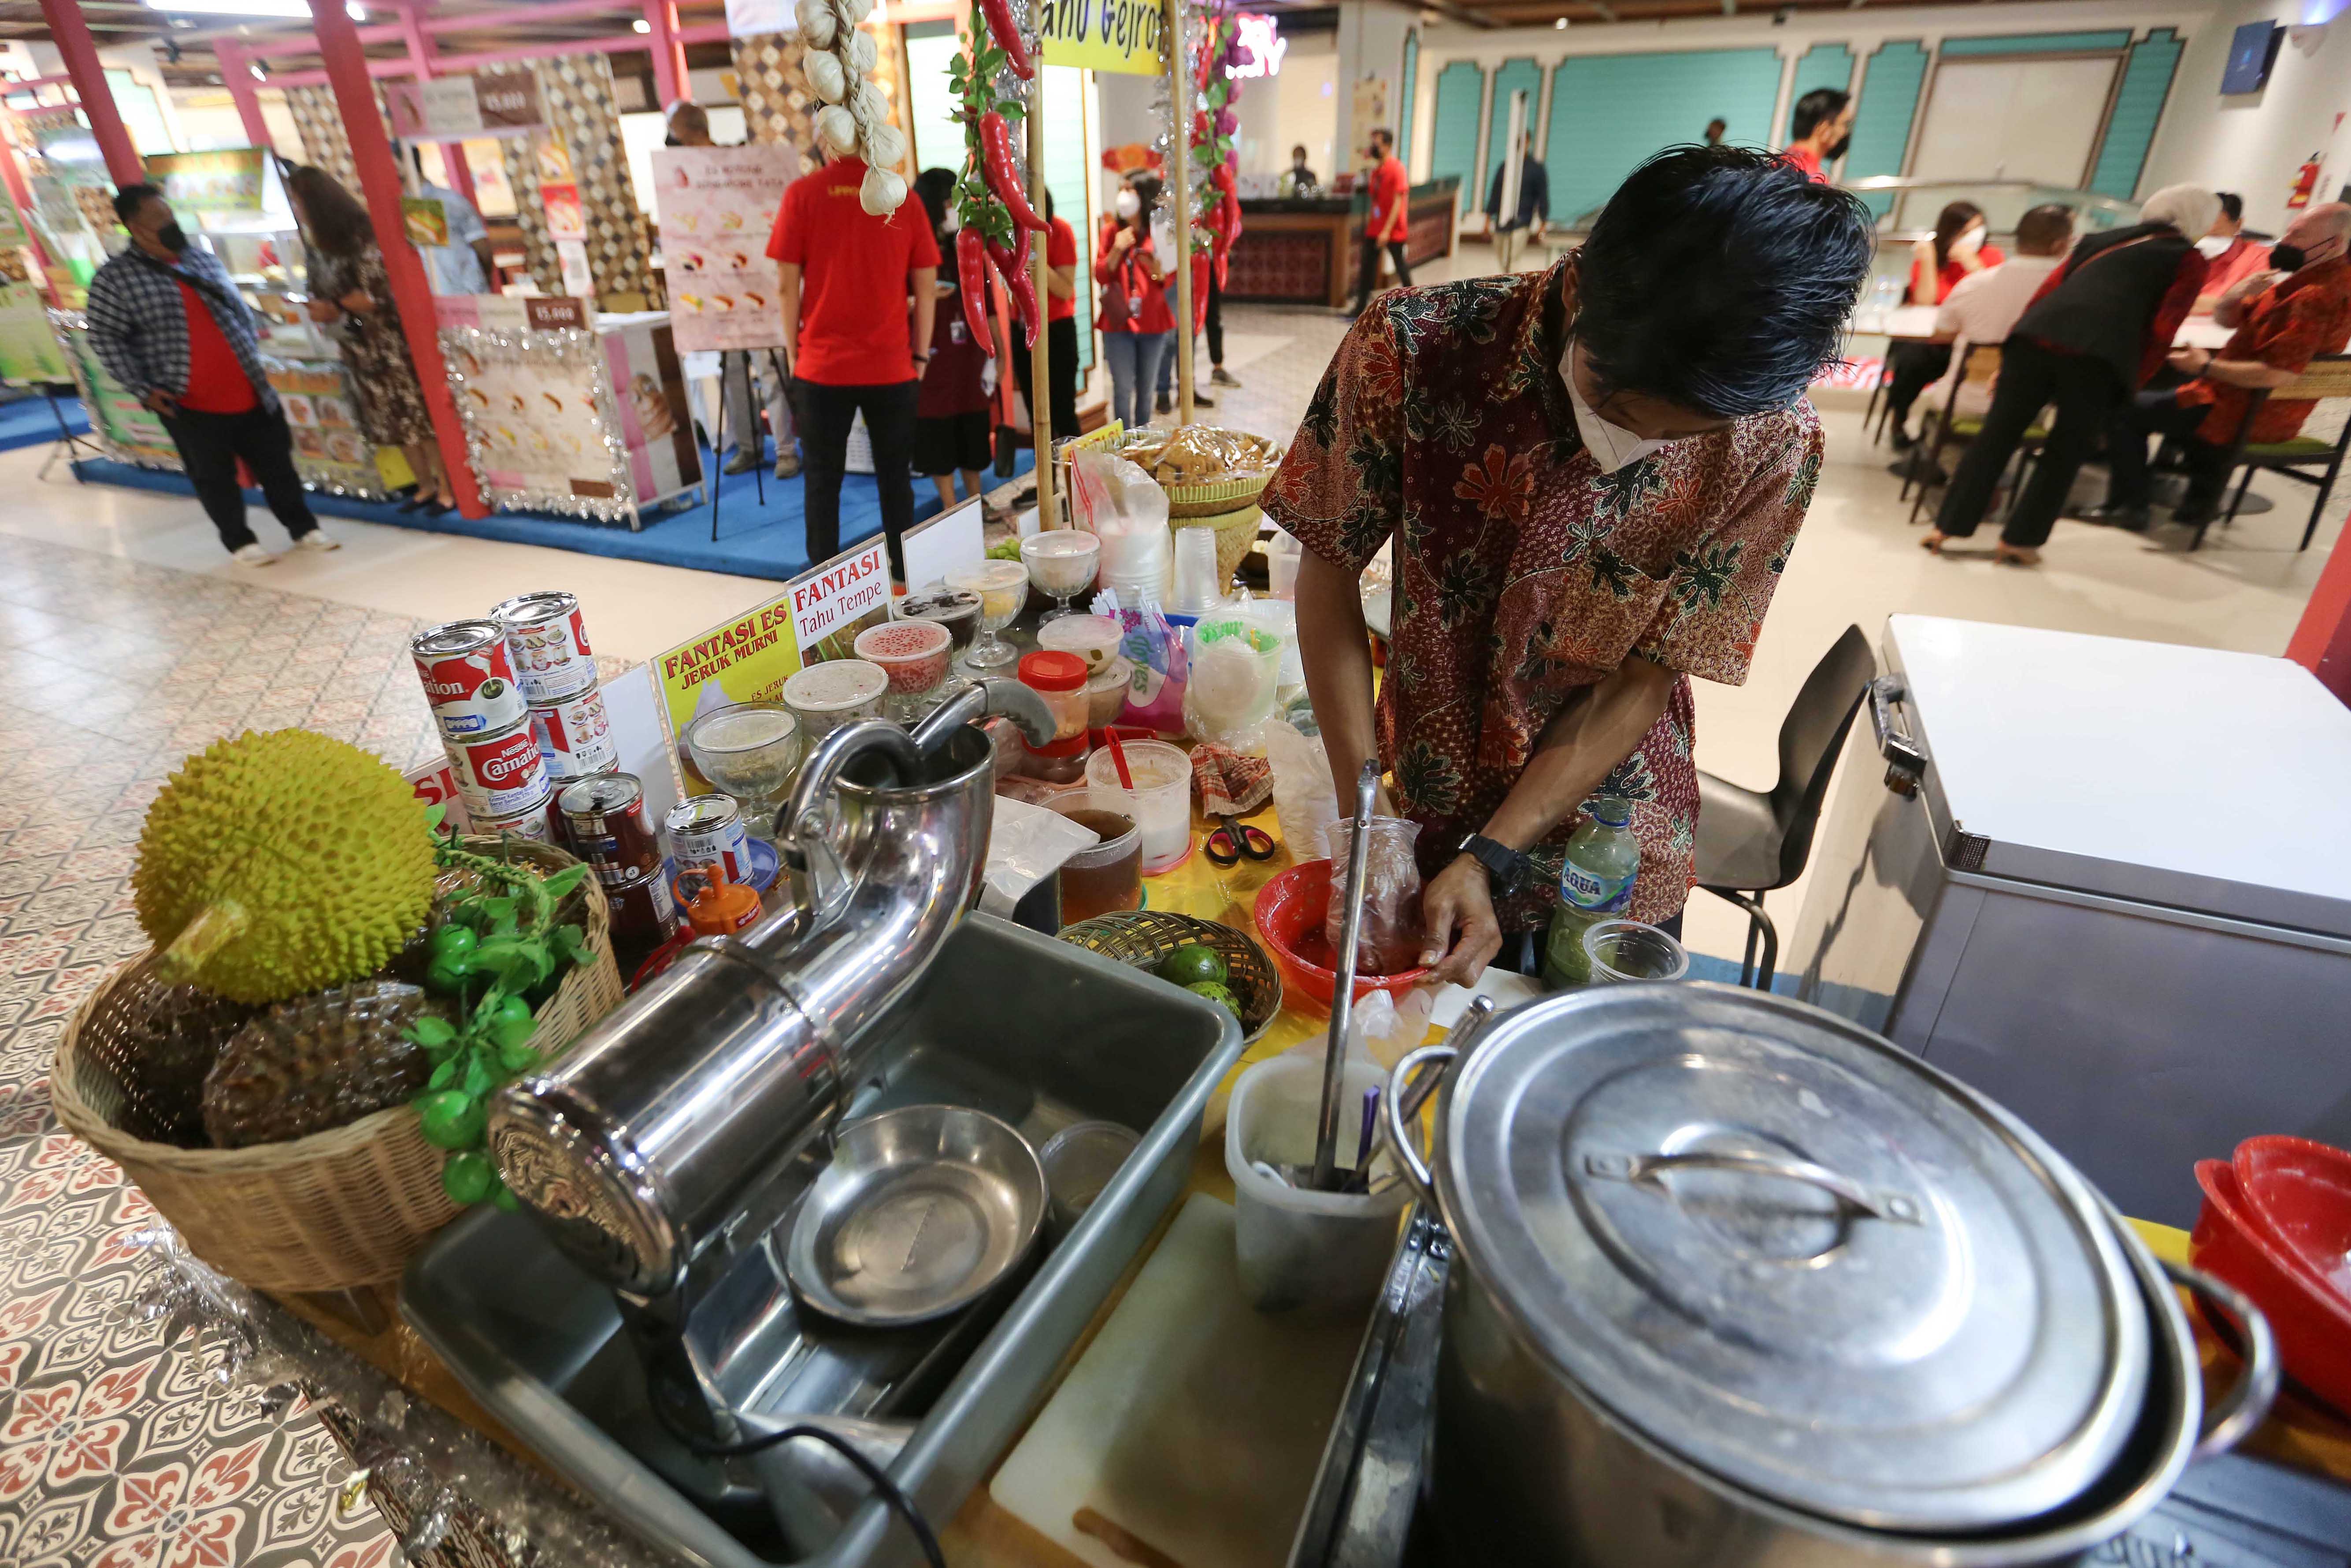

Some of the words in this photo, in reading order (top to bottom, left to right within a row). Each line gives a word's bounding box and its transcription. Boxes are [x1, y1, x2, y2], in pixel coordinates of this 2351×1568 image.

[794, 549, 880, 613] FANTASI
[799, 608, 835, 637] Tahu
[837, 582, 882, 615] Tempe
[665, 618, 756, 679] FANTASI
[760, 604, 787, 631] ES
[682, 653, 731, 690] JERUK
[734, 629, 778, 662] MURNI
[751, 690, 762, 702] ES
[765, 675, 788, 695] JERUK
[1564, 867, 1601, 895] AQUA
